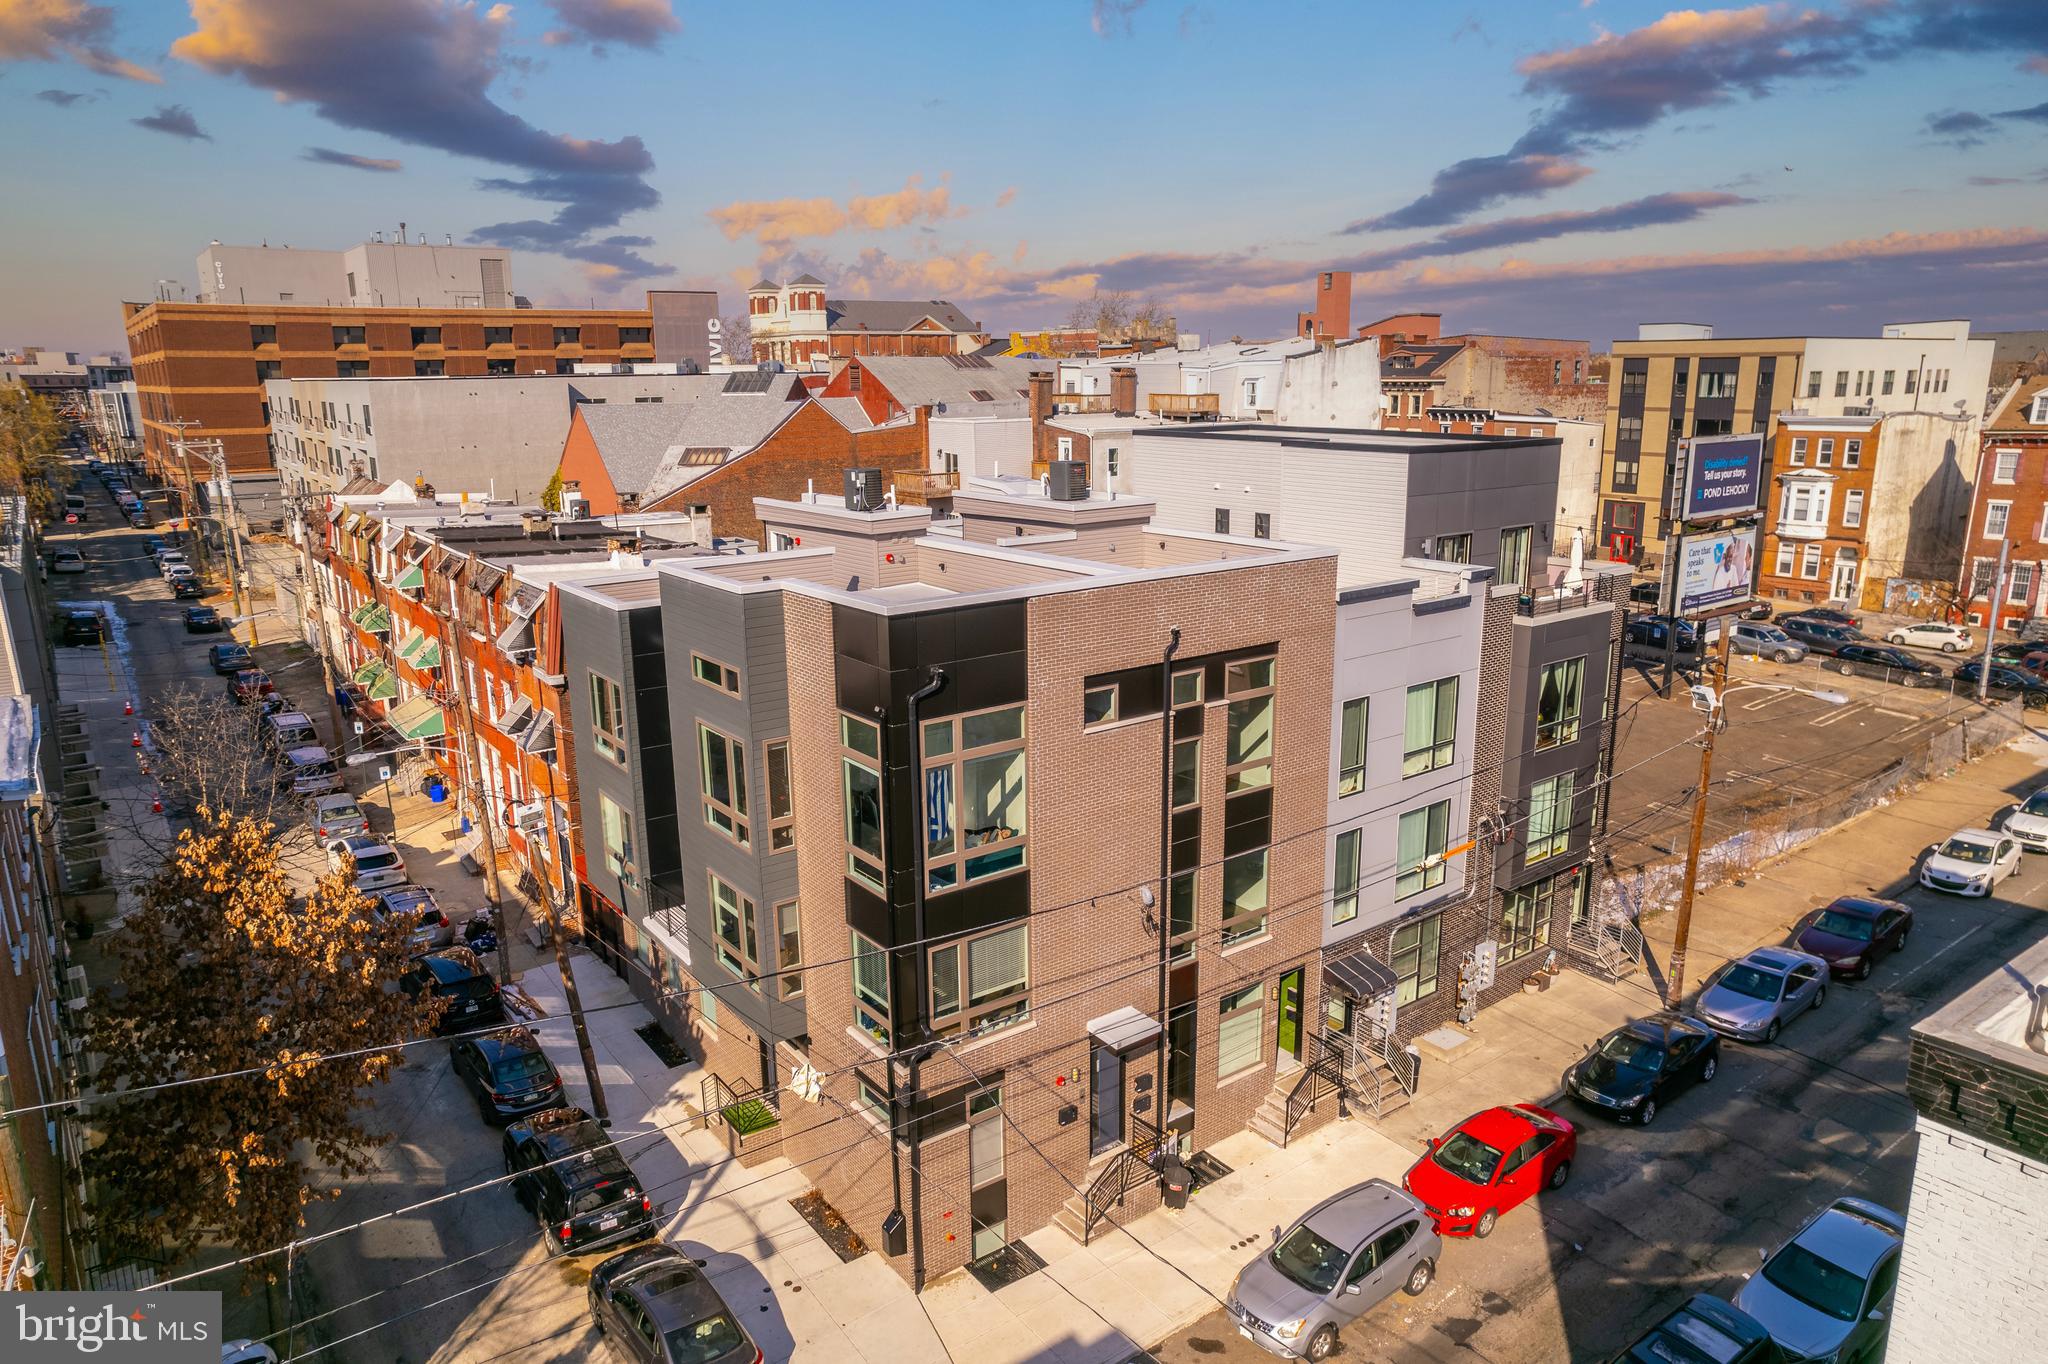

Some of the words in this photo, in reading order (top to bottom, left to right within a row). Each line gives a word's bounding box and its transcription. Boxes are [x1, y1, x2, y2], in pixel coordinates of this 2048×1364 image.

[707, 318, 722, 364] IVIC
[1704, 470, 1714, 480] Tell
[1714, 471, 1720, 479] us
[1720, 470, 1732, 481] your
[1703, 487, 1722, 499] POND
[1722, 483, 1750, 496] LEHOCKY
[1688, 548, 1700, 557] Care
[1701, 546, 1712, 555] that
[1687, 557, 1704, 569] speaks
[1686, 570, 1692, 578] to
